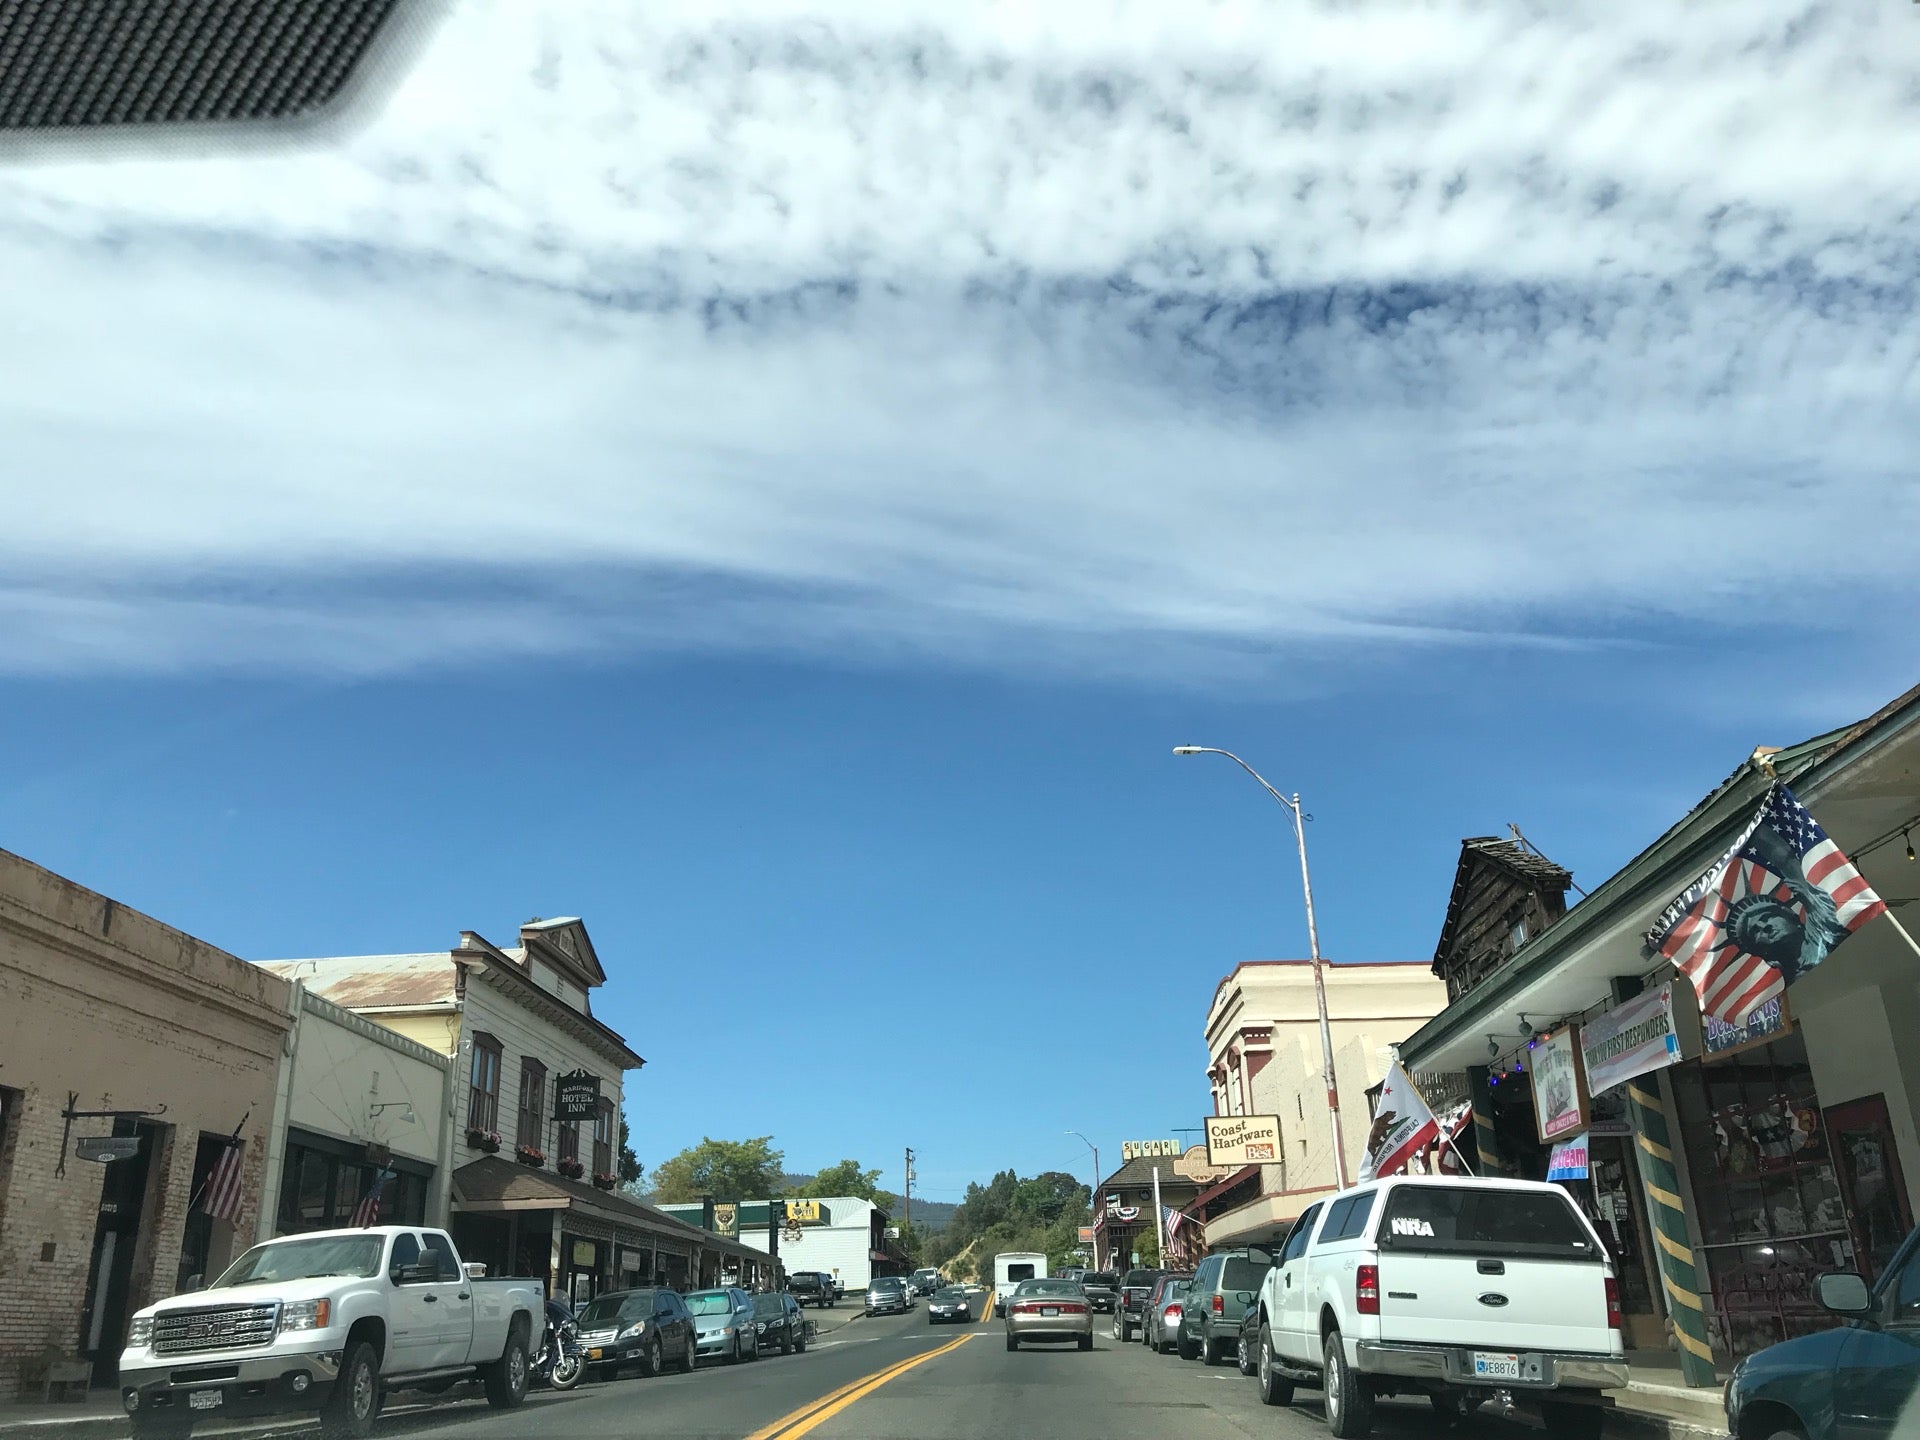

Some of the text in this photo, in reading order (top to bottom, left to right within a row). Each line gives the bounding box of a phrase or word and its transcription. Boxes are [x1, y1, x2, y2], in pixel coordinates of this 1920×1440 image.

[1607, 1032, 1626, 1058] FIRST
[1625, 1012, 1670, 1048] RESPONDERS
[561, 1094, 594, 1102] HOTEL
[568, 1103, 586, 1112] INN
[1211, 1119, 1247, 1137] Coast
[1124, 1141, 1169, 1150] SUGAR
[1213, 1129, 1273, 1149] Hardware
[1246, 1146, 1273, 1159] Best
[1391, 1220, 1435, 1236] NRA
[186, 1320, 237, 1338] GMC
